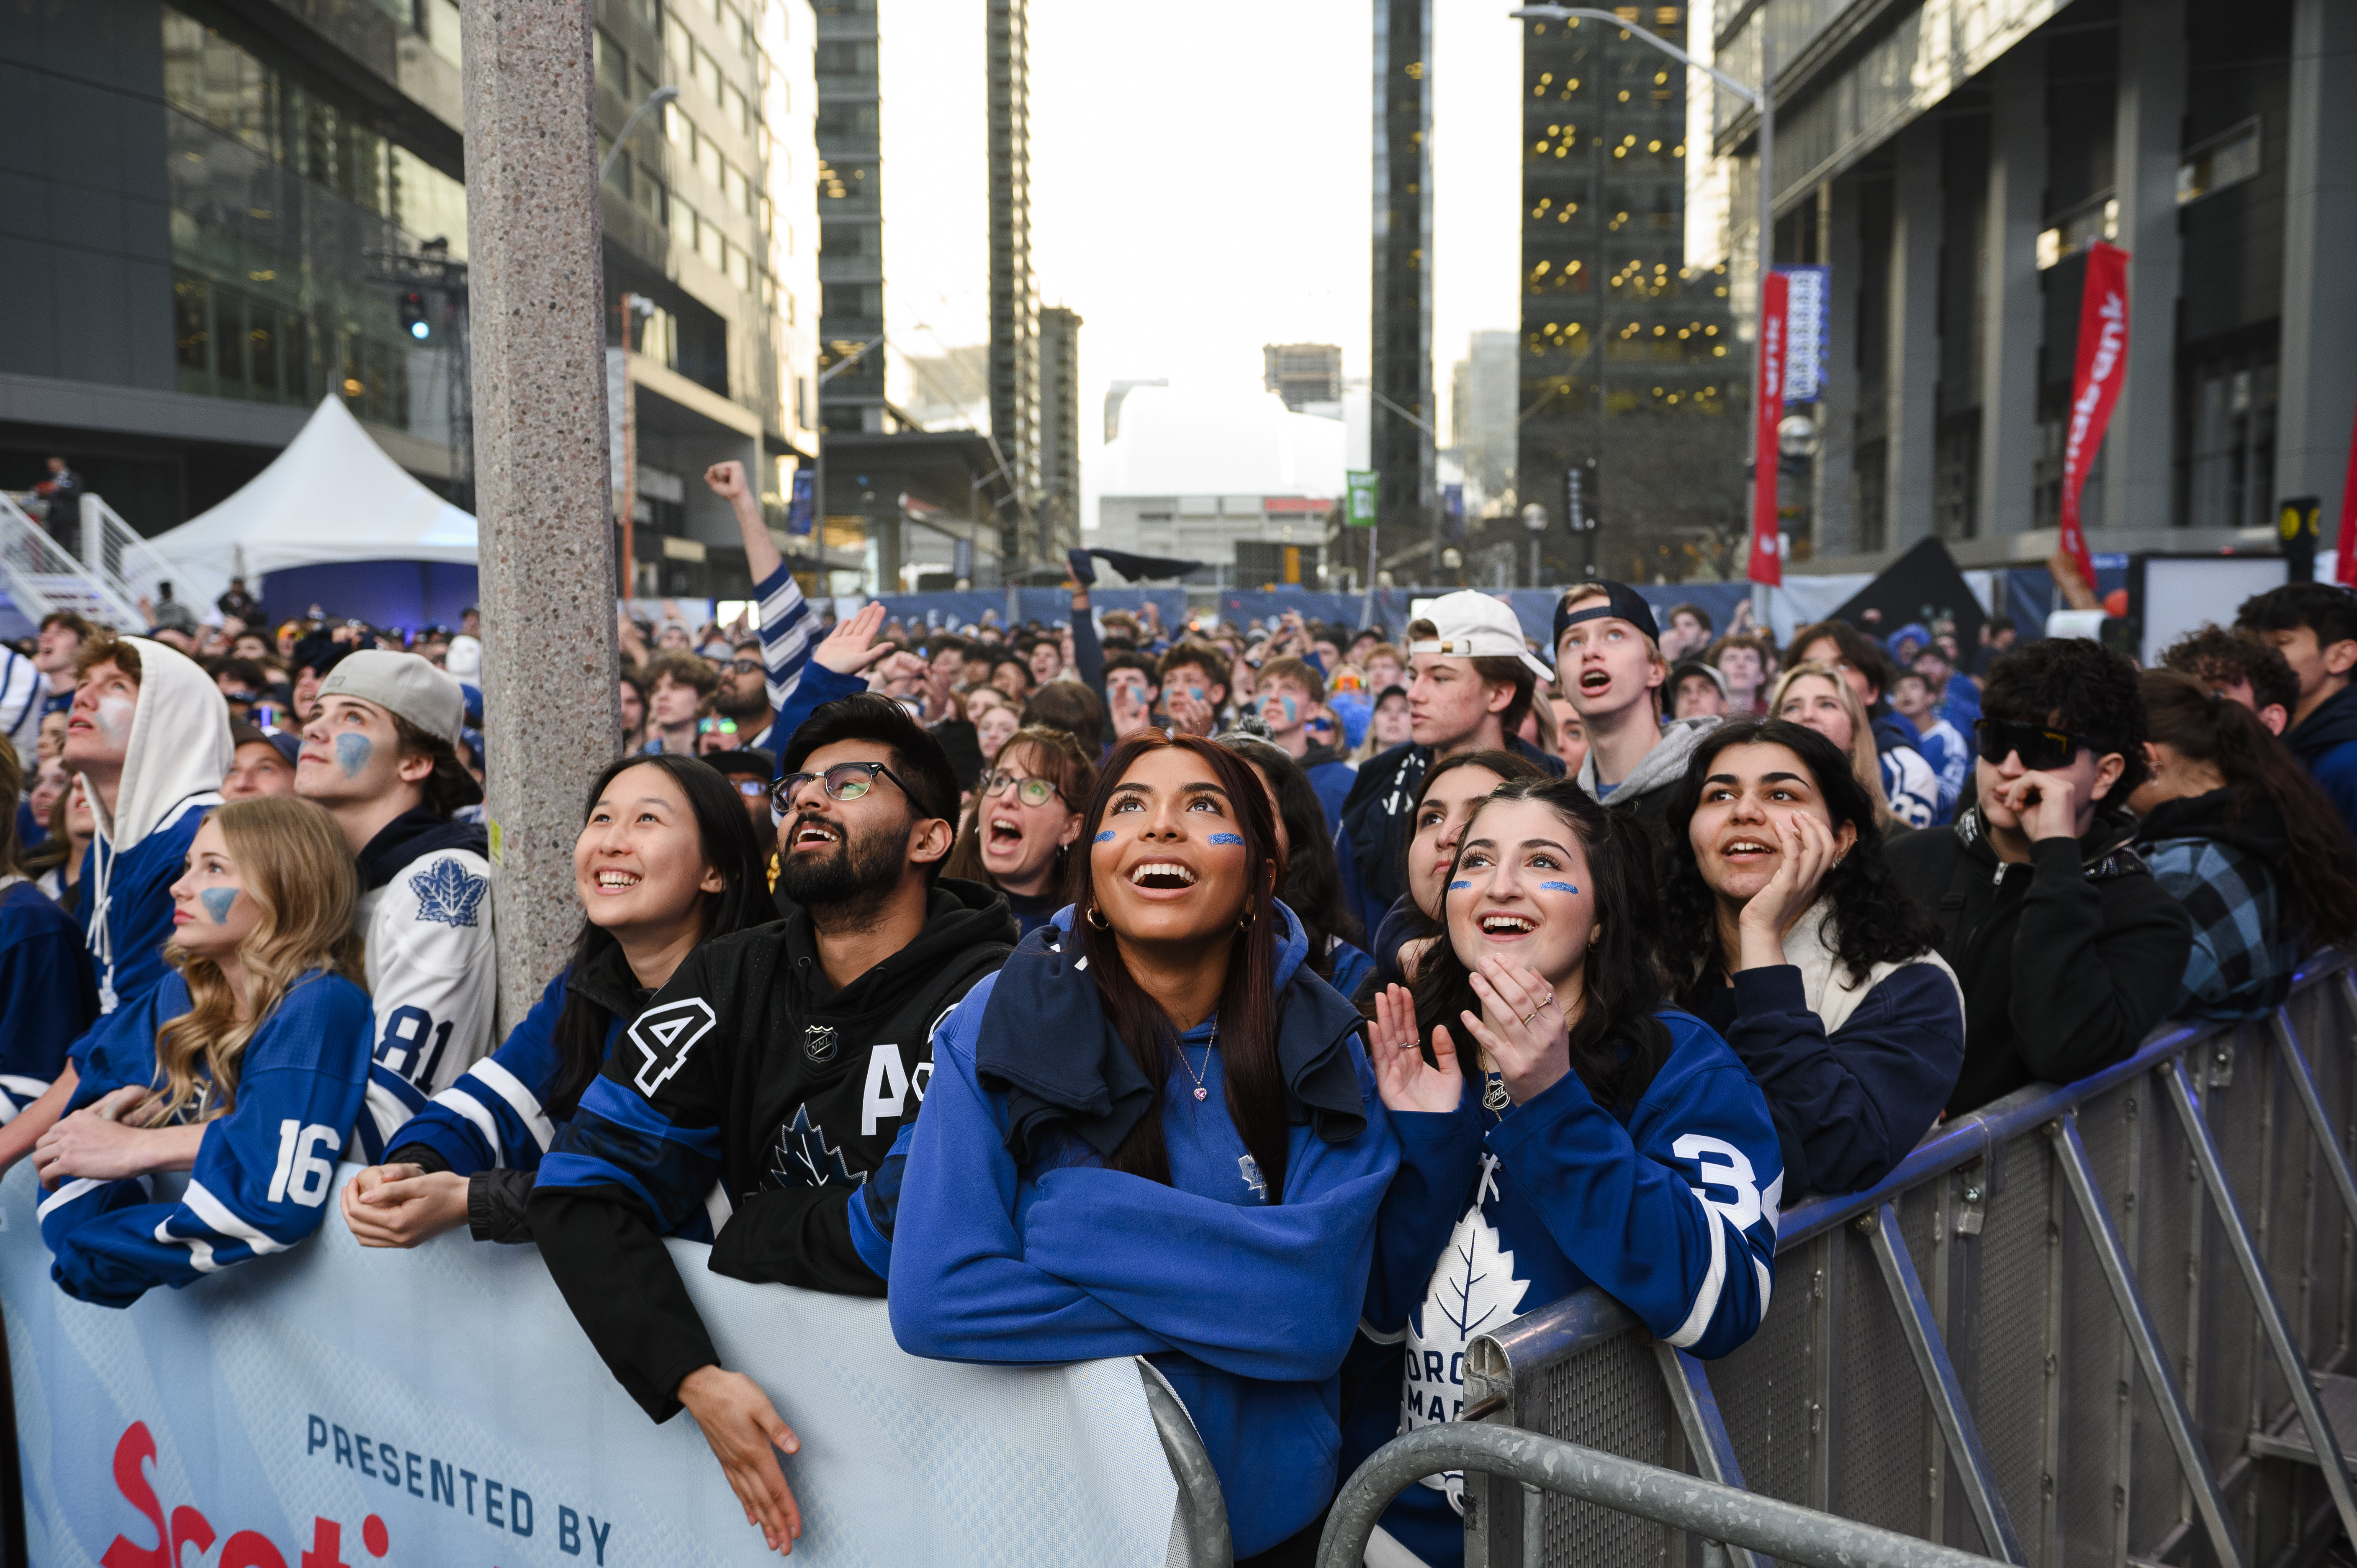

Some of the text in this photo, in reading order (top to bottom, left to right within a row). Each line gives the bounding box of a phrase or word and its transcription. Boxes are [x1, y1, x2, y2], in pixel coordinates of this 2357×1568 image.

[373, 1005, 454, 1095] 81
[811, 1037, 830, 1053] NHL
[861, 1044, 909, 1135] A
[267, 1119, 342, 1208] 16
[1403, 1348, 1465, 1386] ORO
[307, 1414, 611, 1568] PRESENTED BY
